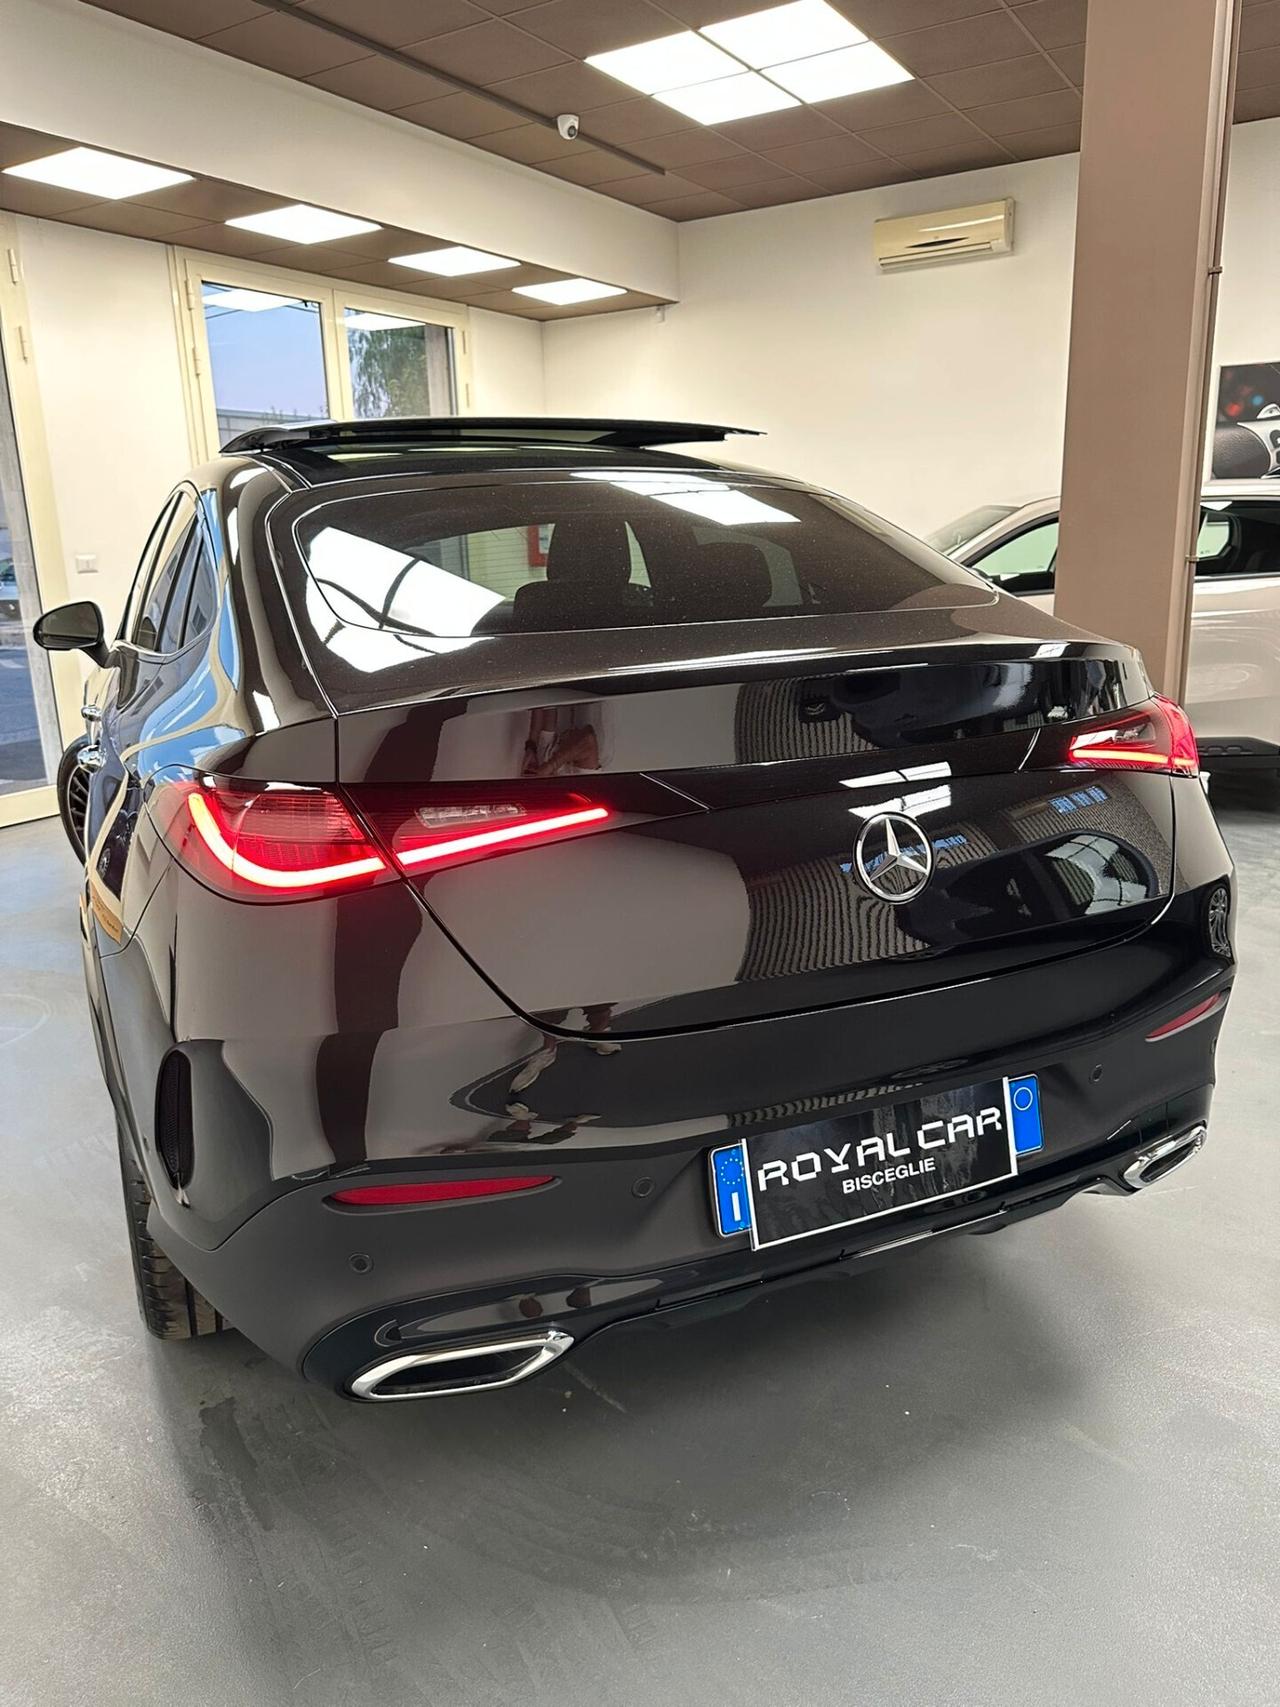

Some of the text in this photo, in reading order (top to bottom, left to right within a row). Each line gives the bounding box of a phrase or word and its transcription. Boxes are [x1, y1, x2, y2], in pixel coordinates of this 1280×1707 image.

[757, 1106, 1003, 1192] ROYAL CAR
[842, 1157, 936, 1195] BISCEGLIE
